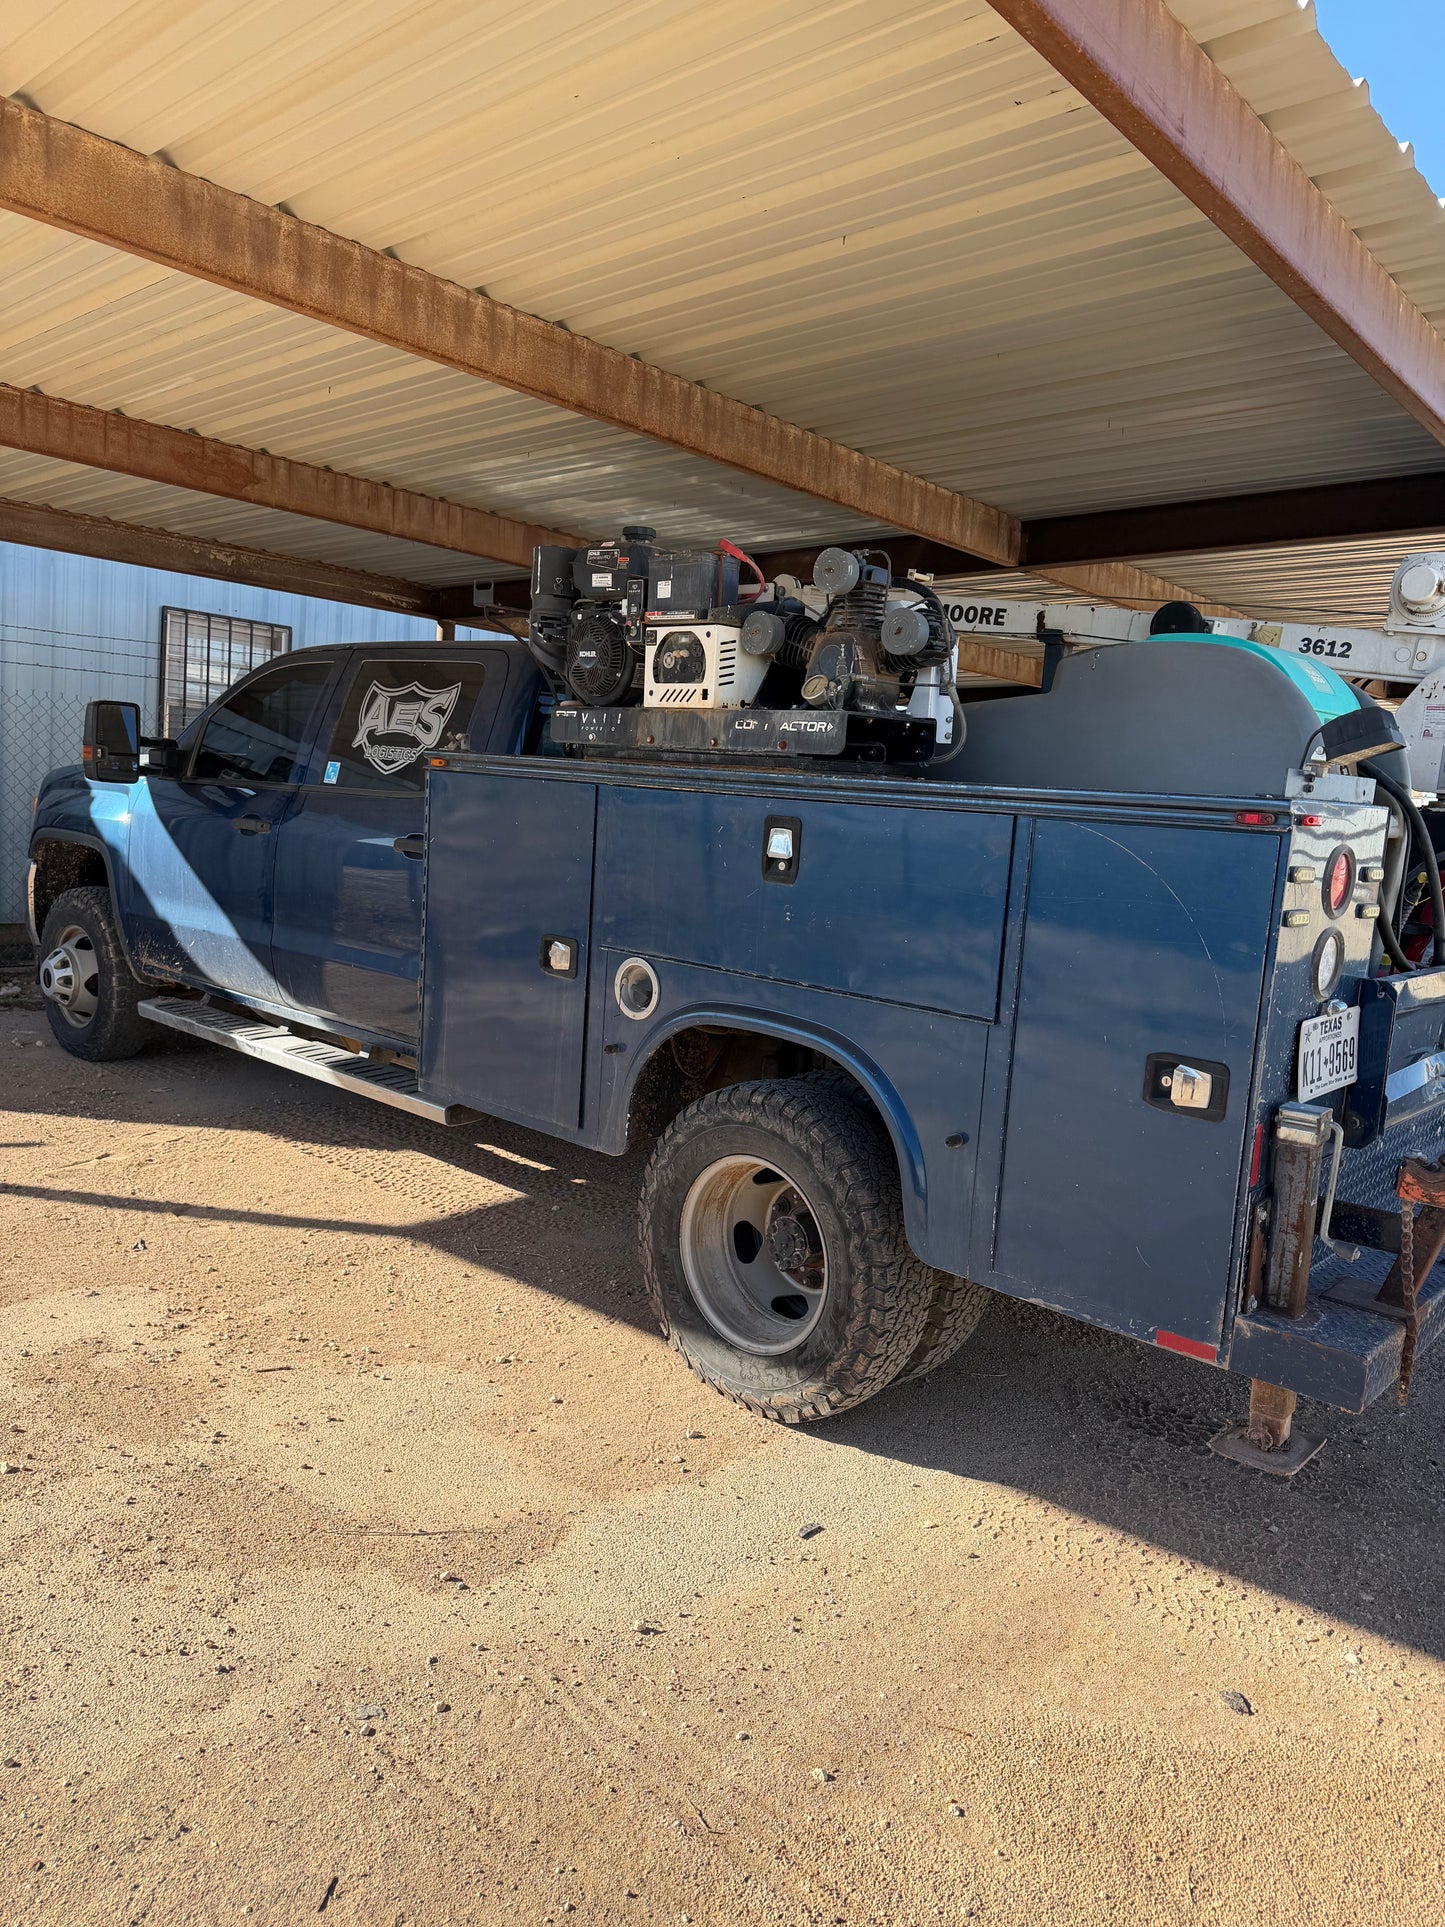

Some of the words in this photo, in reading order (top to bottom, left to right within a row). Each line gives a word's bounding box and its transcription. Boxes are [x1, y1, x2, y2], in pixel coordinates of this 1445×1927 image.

[1298, 637, 1352, 658] 3612
[352, 687, 458, 748] AES
[364, 744, 419, 762] LOGISTICS
[1320, 1016, 1342, 1035] TEXAS
